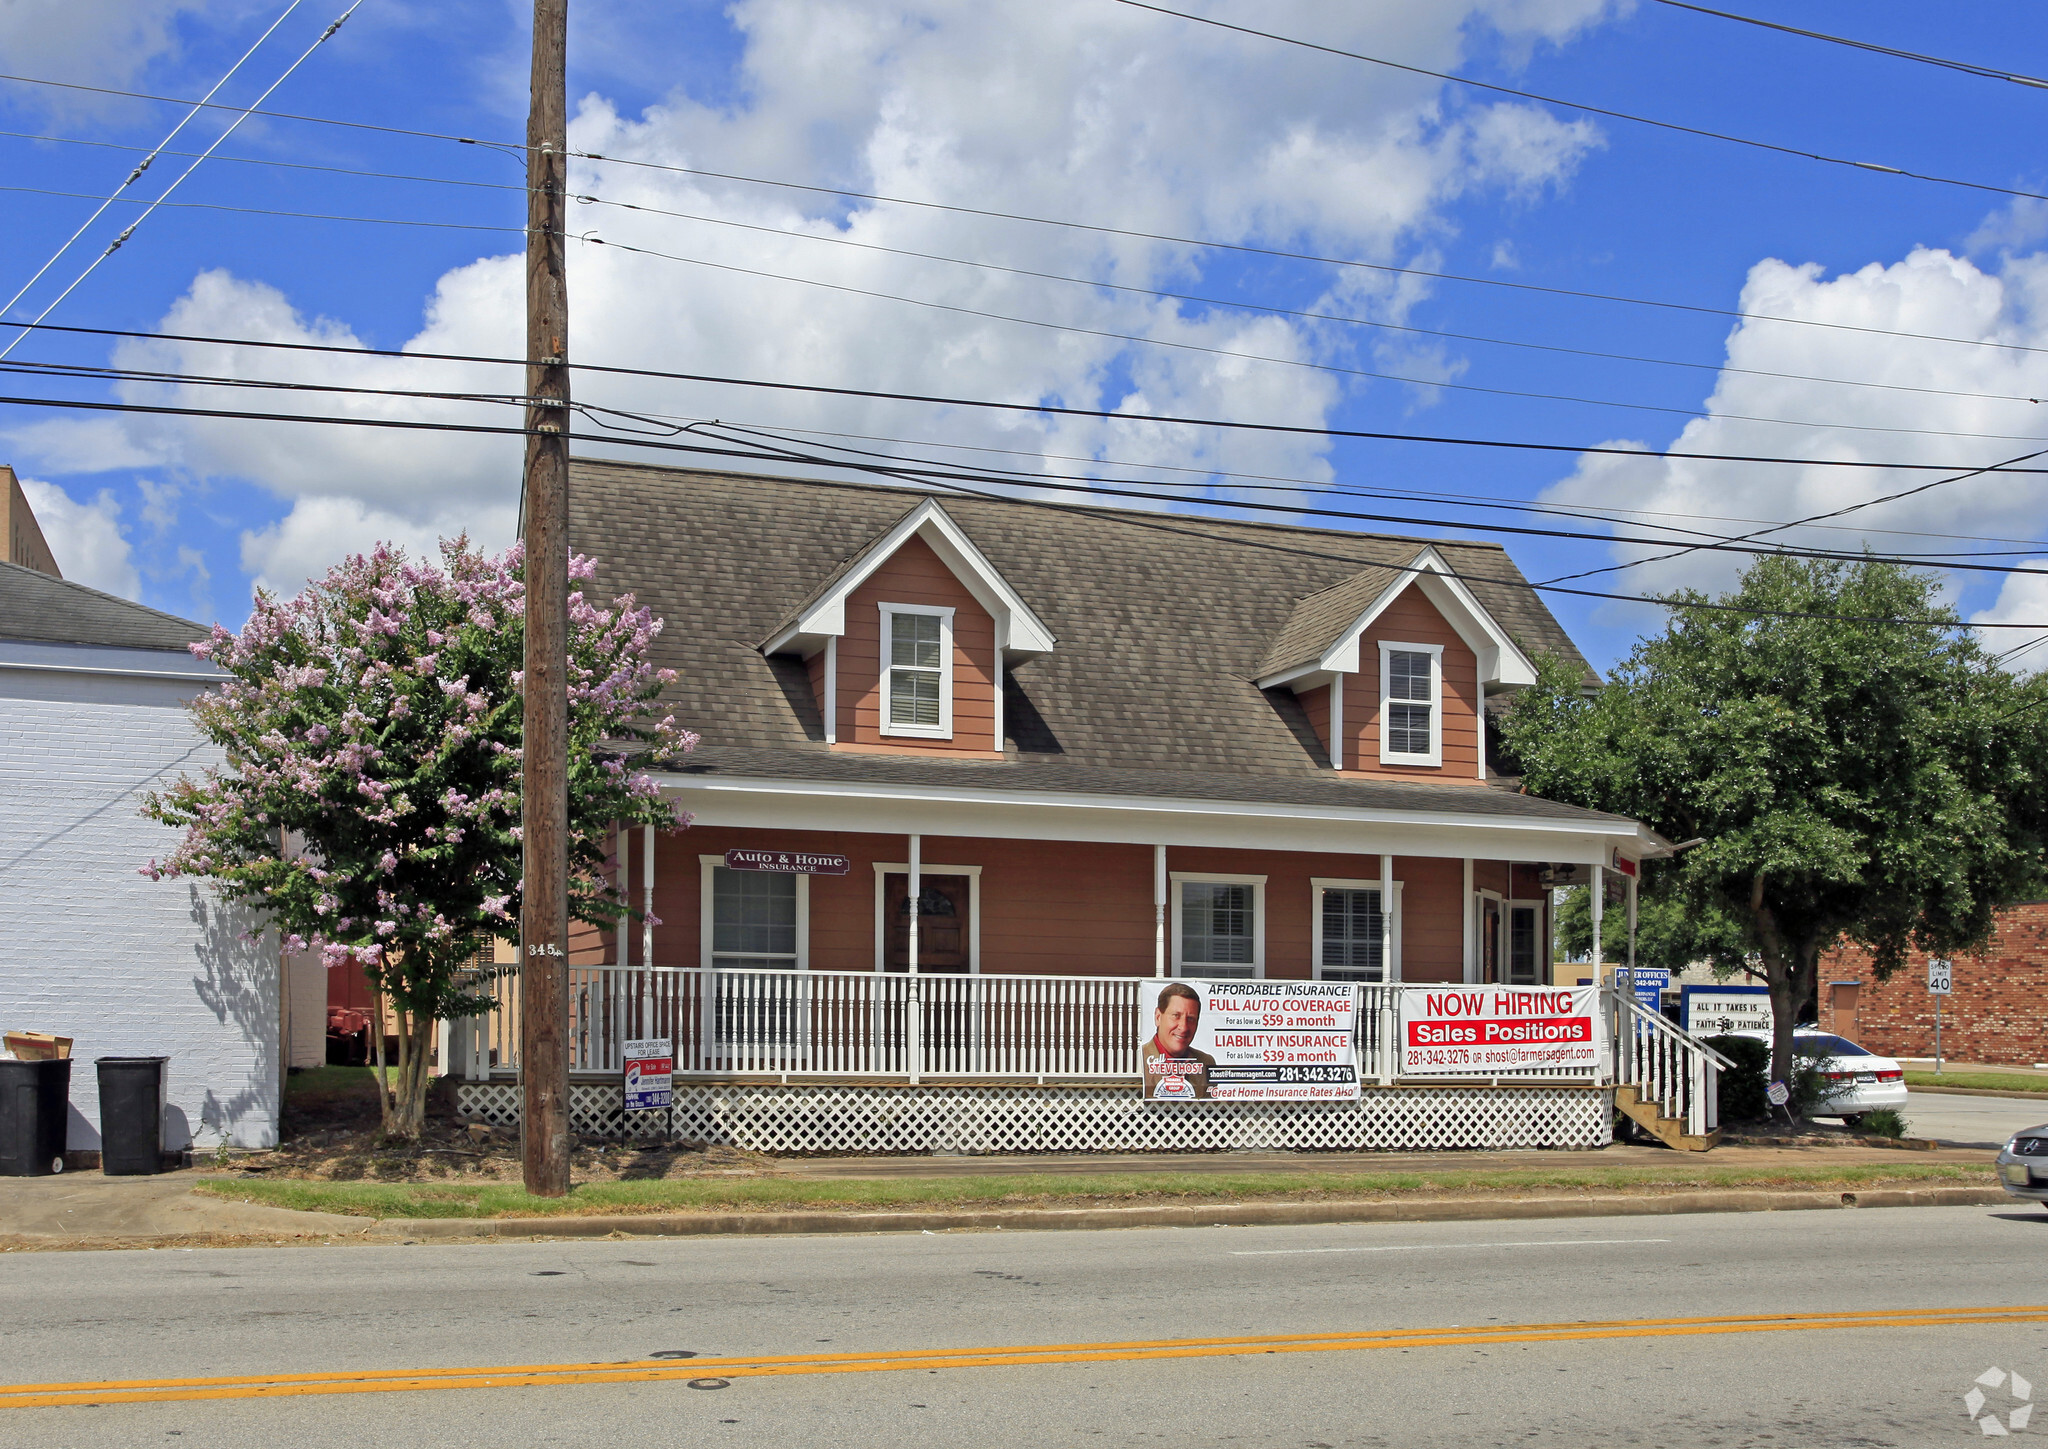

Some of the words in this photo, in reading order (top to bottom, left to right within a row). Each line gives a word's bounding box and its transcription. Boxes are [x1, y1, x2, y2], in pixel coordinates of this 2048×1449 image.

[733, 851, 772, 863] Auto
[778, 854, 789, 864] &
[795, 854, 843, 866] Home
[759, 863, 816, 871] INSURANCE
[1642, 971, 1668, 979] OFFICES
[1208, 984, 1282, 996] AFFORDABLE
[1285, 985, 1351, 996] INSURANCE!
[1931, 978, 1949, 990] 40
[1209, 999, 1240, 1011] FULL
[1242, 999, 1280, 1011] AUTO
[1282, 999, 1351, 1012] COVERAGE
[1427, 993, 1484, 1016] NOW
[1495, 992, 1573, 1015] HIRING
[1697, 1003, 1709, 1011] ALL
[1714, 1003, 1721, 1011] IT
[1726, 1003, 1747, 1012] TAKES
[1750, 1004, 1757, 1012] IS
[1225, 1016, 1235, 1024] For
[1243, 1016, 1254, 1025] low
[1262, 1013, 1284, 1027] $59
[1286, 1017, 1294, 1026] a
[1296, 1014, 1335, 1027] month
[1696, 1020, 1716, 1028] FAITH
[1738, 1020, 1770, 1029] PATIENCE
[1416, 1024, 1477, 1043] Sales
[1485, 1022, 1584, 1041] Positions
[1215, 1035, 1273, 1047] LIABILITY
[1277, 1035, 1347, 1047] INSURANCE
[1146, 1053, 1166, 1066] Call
[1226, 1051, 1236, 1059] For
[1244, 1051, 1254, 1059] low
[1263, 1049, 1285, 1063] $39
[1287, 1053, 1294, 1062] a
[1297, 1050, 1336, 1062] month
[1407, 1049, 1469, 1065] 281-342-3276
[1472, 1052, 1482, 1063] OR
[1485, 1047, 1595, 1064] shost@farmersagent.com
[1149, 1063, 1178, 1074] STEVE
[1179, 1063, 1203, 1074] HOST
[1209, 1068, 1277, 1079] shost@farmersagent.com
[1279, 1067, 1353, 1081] 281-342-3276
[1237, 1087, 1264, 1097] Home
[1265, 1087, 1308, 1097] Insurance
[1309, 1086, 1333, 1097] Rates
